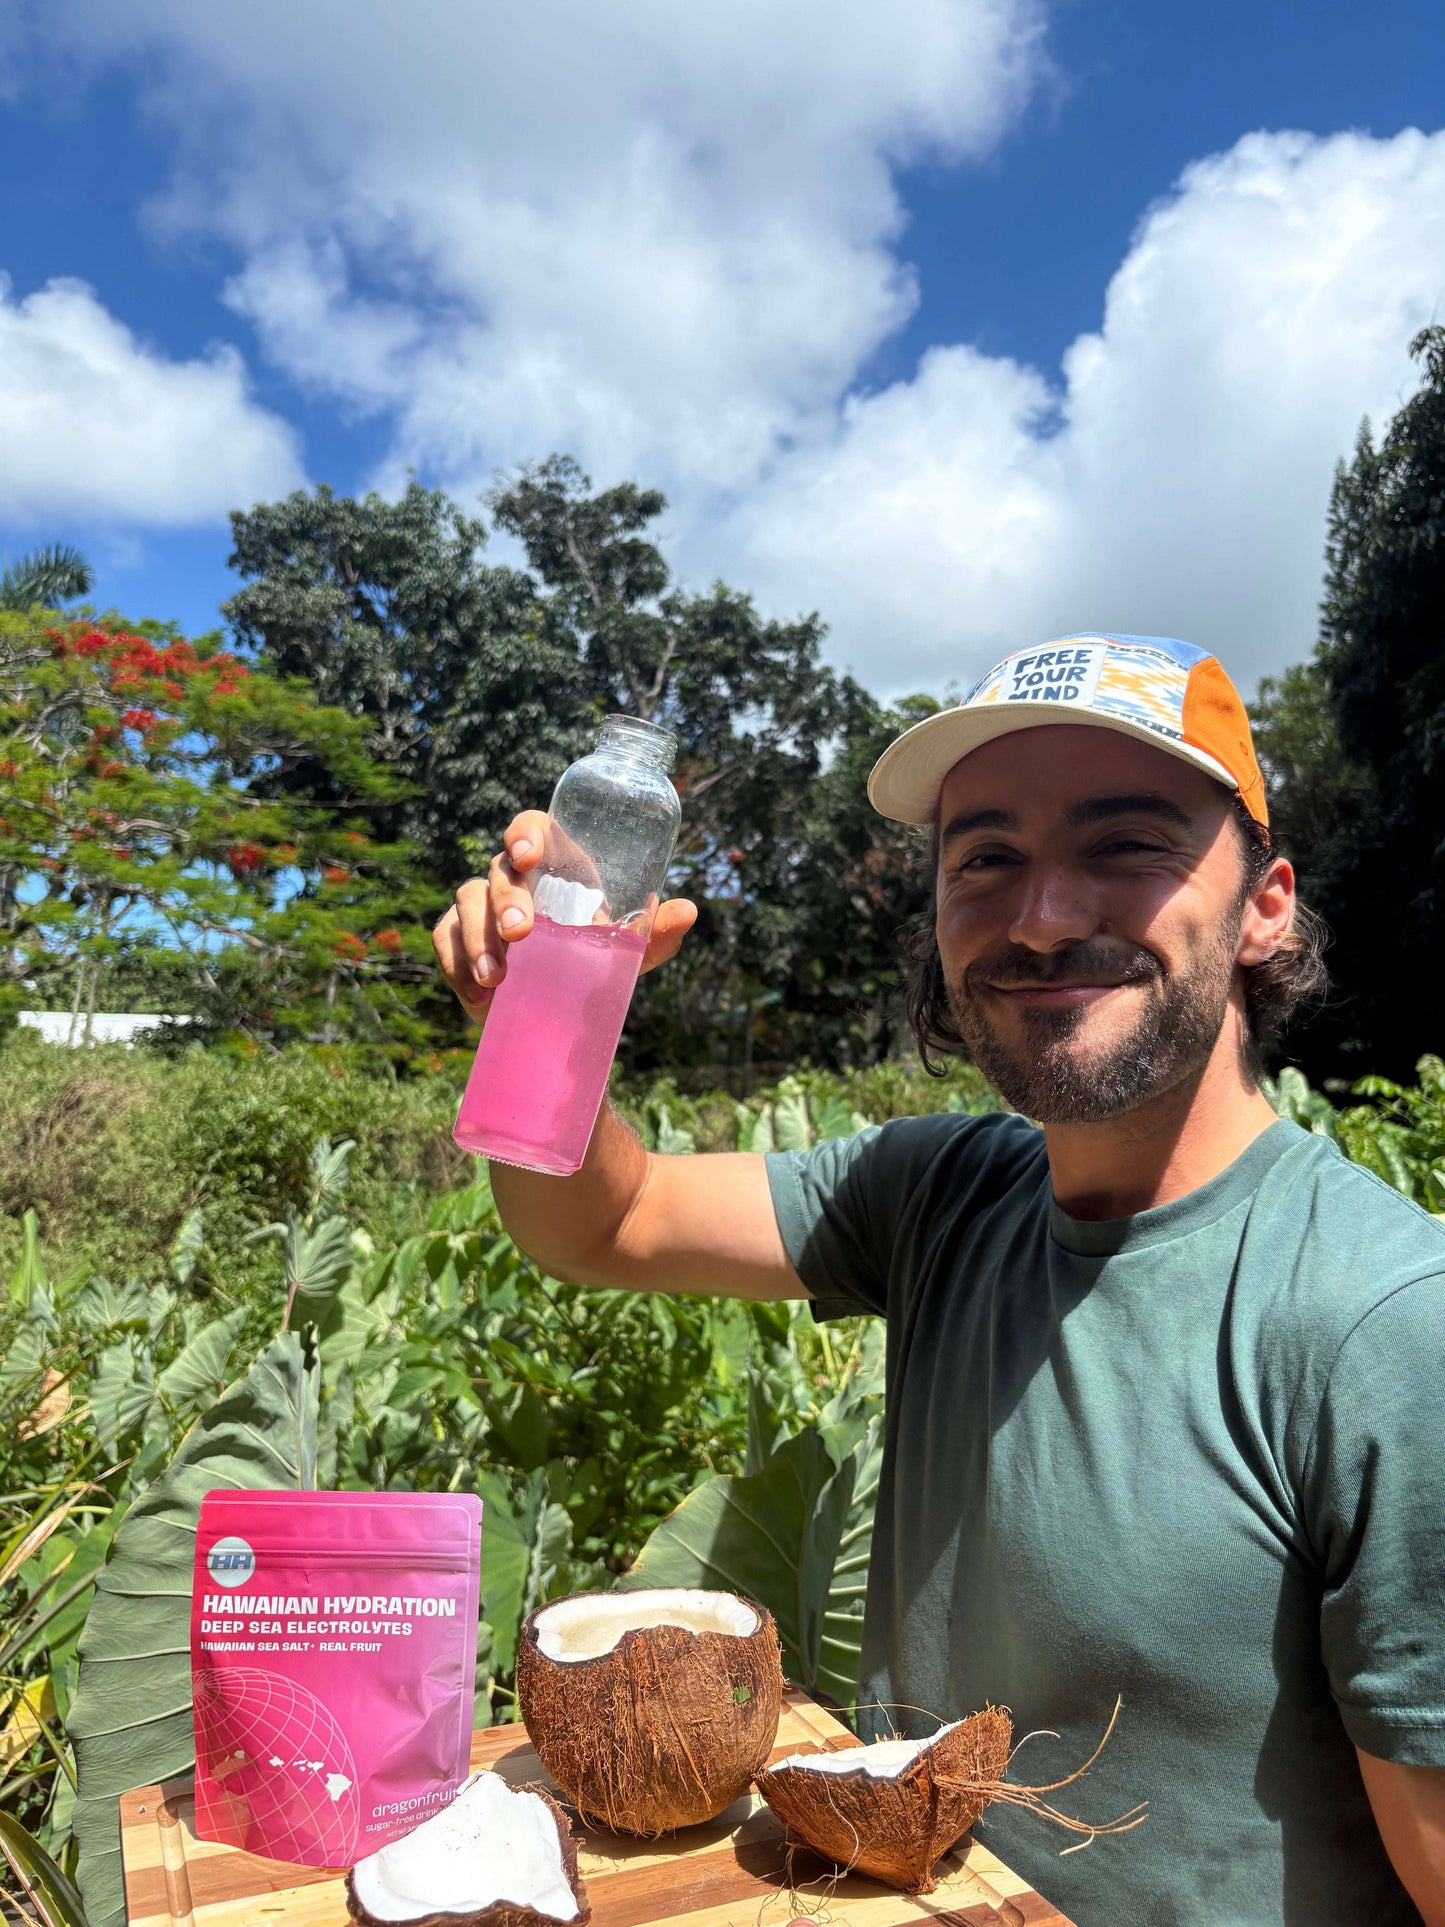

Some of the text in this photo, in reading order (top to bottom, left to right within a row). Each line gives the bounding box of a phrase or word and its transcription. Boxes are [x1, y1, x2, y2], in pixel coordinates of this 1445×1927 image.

[1013, 649, 1093, 676] FREE
[1012, 666, 1088, 691] YOUR
[211, 1555, 253, 1570] HH
[202, 1594, 457, 1617] HAWAIIAN HYDRATION
[200, 1620, 414, 1636] DEEP SEA ELECTROLYTES
[200, 1641, 256, 1652] HAWAIIAN
[257, 1641, 280, 1652] SEA
[319, 1642, 349, 1652] REAL
[349, 1642, 383, 1653] FRUIT
[372, 1788, 457, 1818] dragonfruit
[365, 1815, 415, 1832] sugar-free
